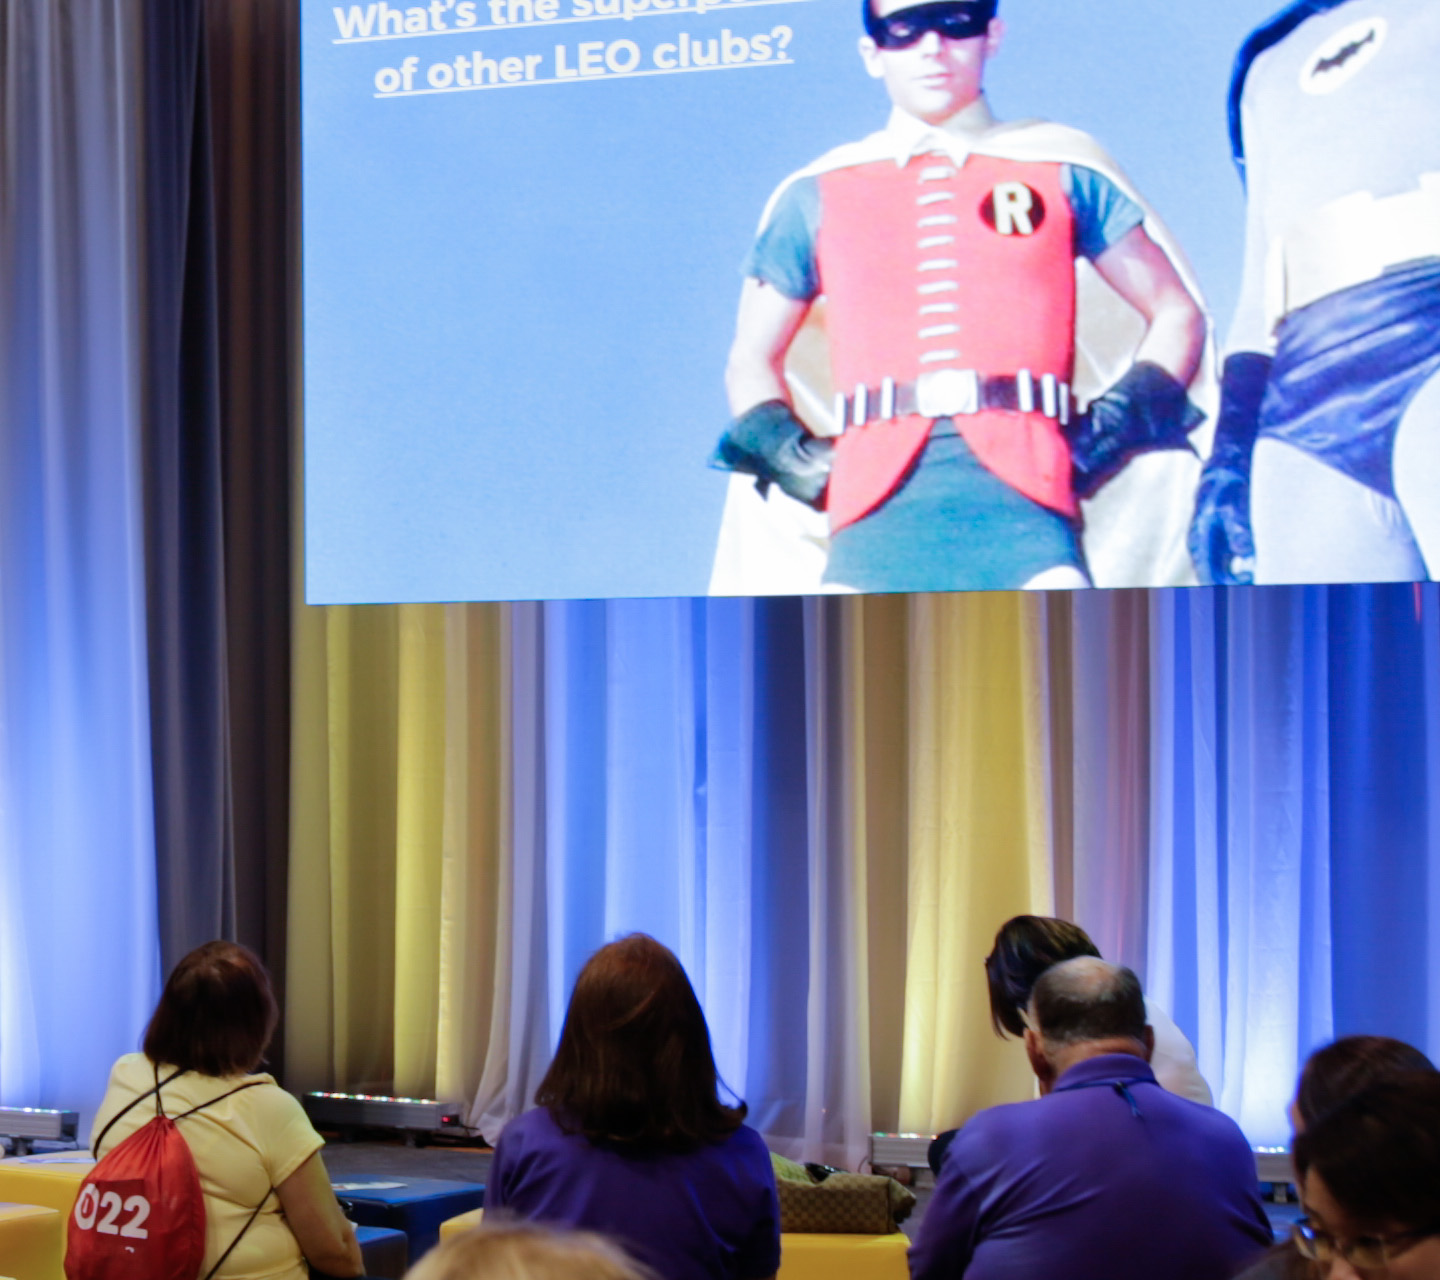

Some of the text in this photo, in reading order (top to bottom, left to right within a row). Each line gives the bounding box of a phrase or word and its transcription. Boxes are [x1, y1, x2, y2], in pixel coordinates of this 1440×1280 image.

[375, 25, 794, 93] of other LEO clubs?
[992, 181, 1035, 236] R
